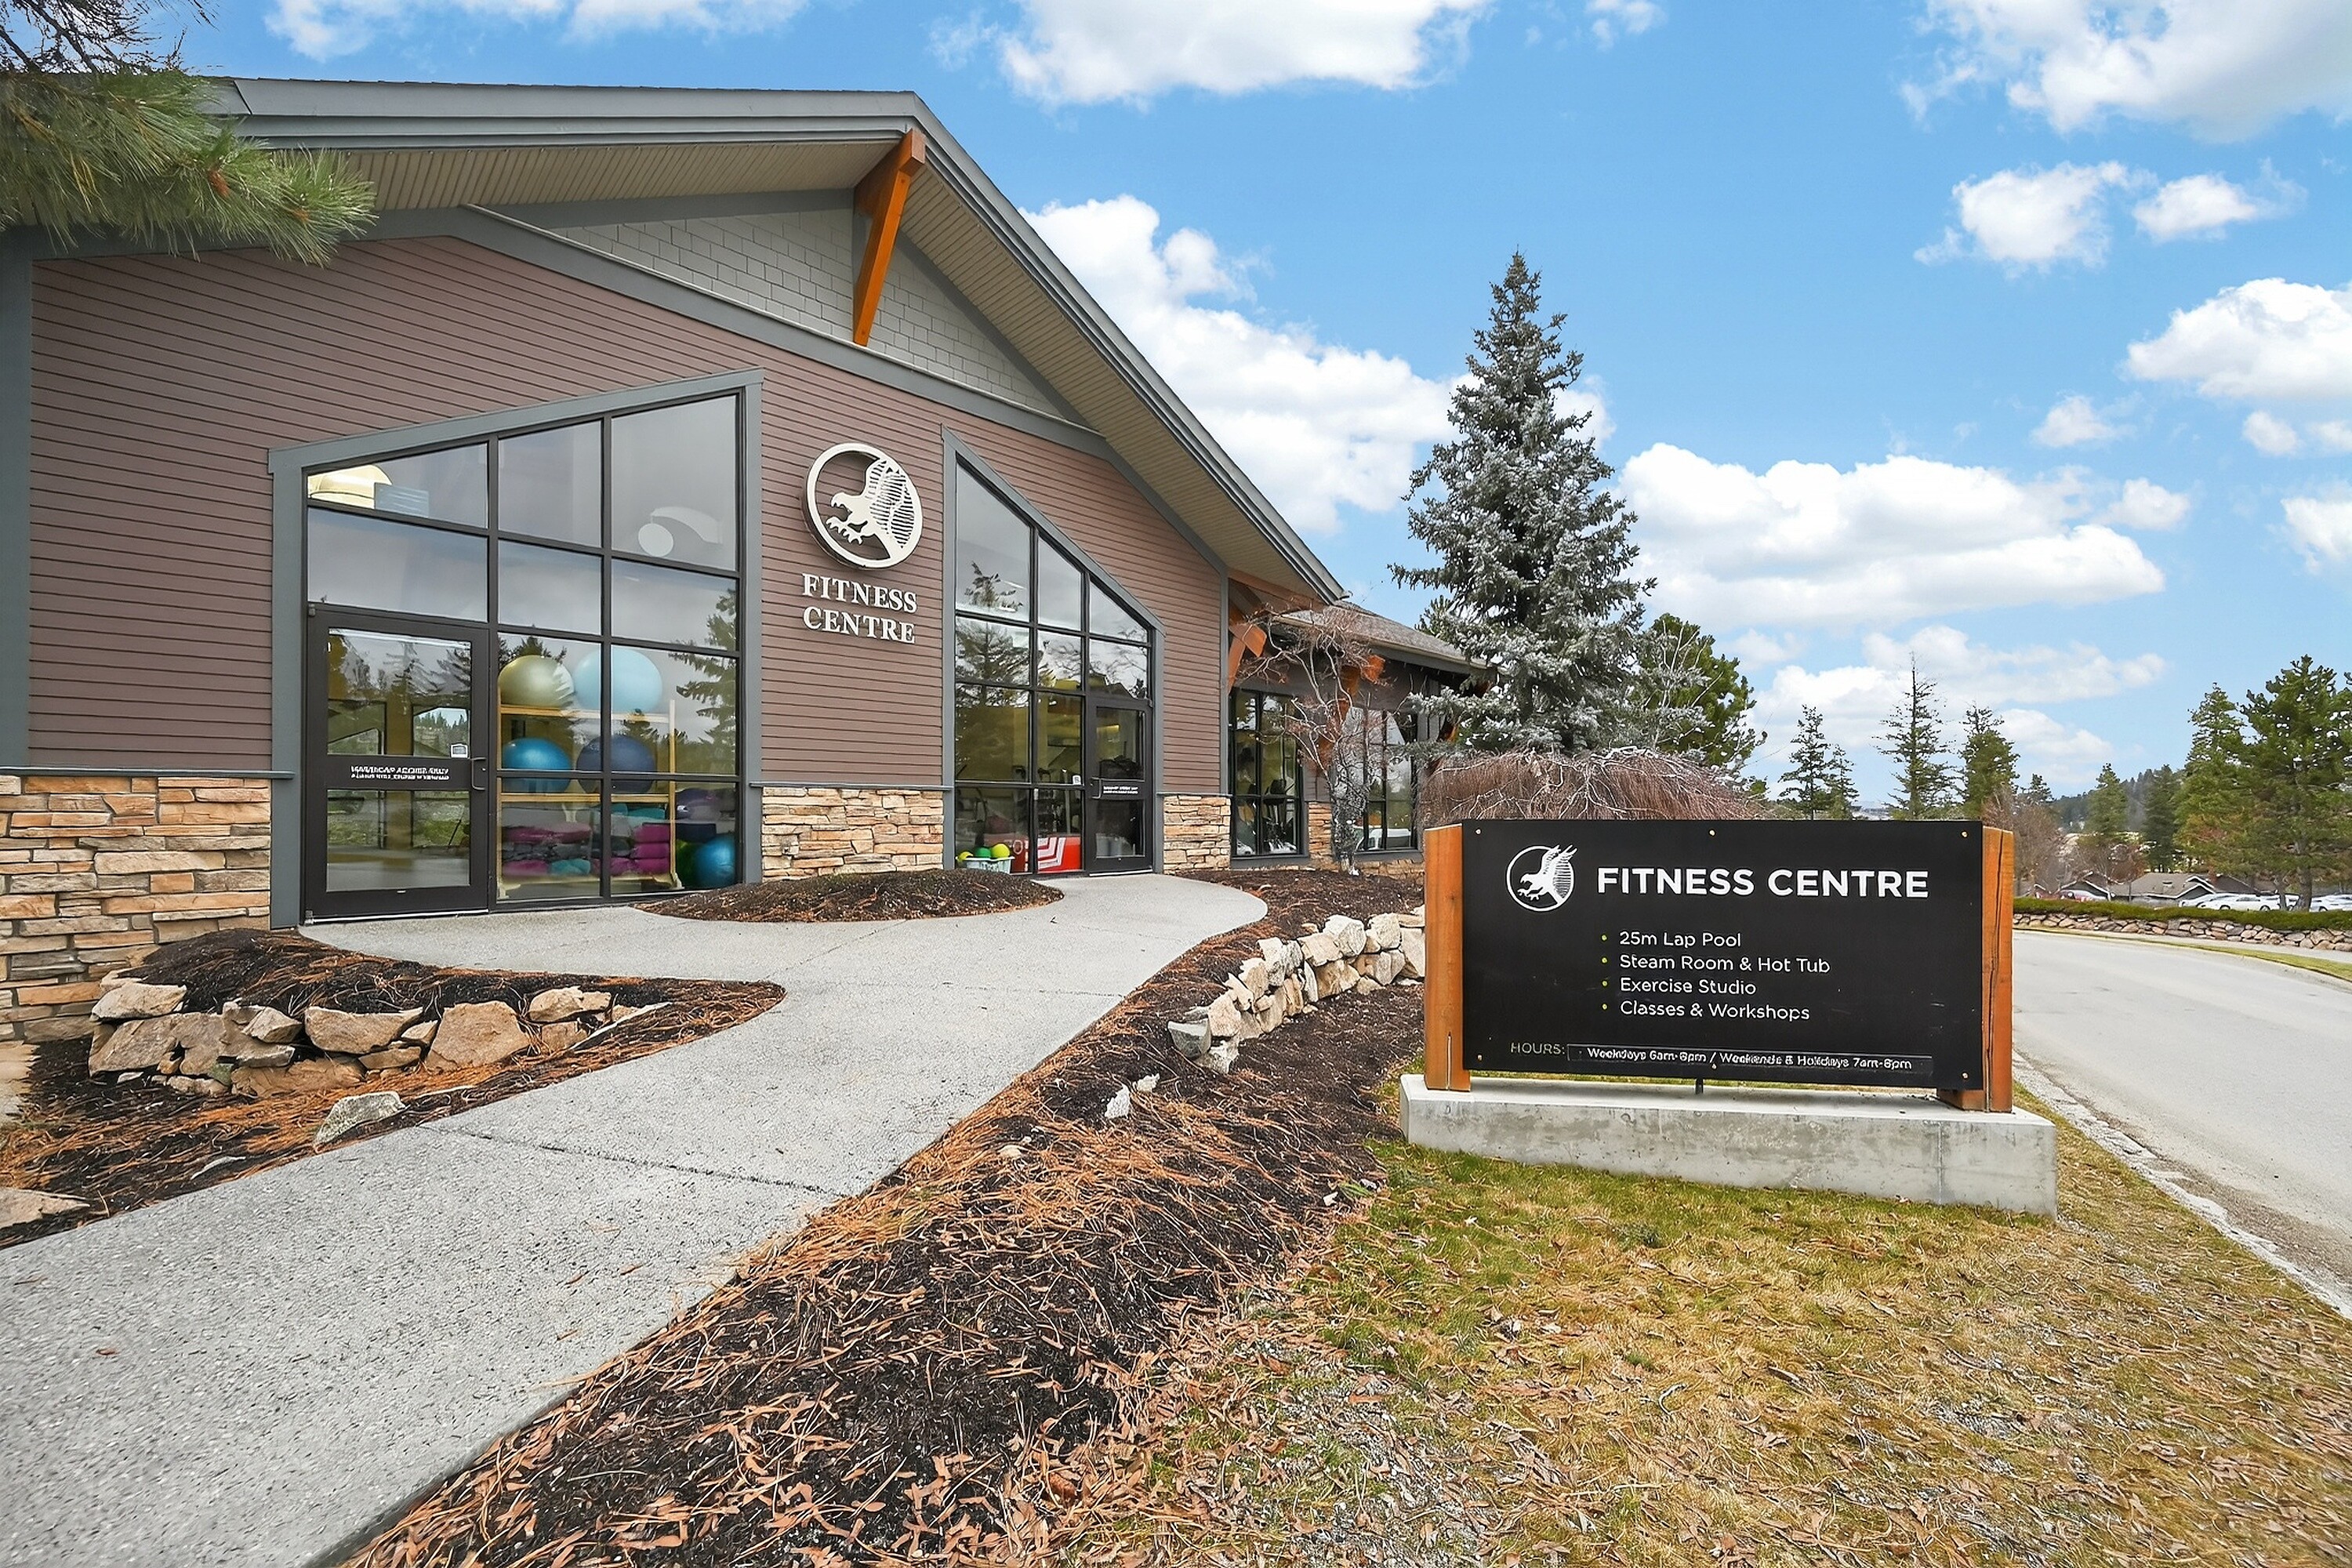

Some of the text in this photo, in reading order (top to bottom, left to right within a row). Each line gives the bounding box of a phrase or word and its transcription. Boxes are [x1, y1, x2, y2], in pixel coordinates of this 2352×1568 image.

[802, 573, 917, 613] FITNESS
[803, 606, 916, 644] CENTRE
[1597, 867, 1929, 898] FITNESS CENTRE
[1620, 931, 1742, 948] 25m Lap Pool
[1620, 954, 1831, 974] Steam Room & Hot Tub
[1620, 977, 1756, 995] Exercise Studio
[1620, 1000, 1810, 1022] Classes & Workshops
[1510, 1042, 1566, 1055] HOURS:
[1587, 1047, 1647, 1062] Weekdays
[1719, 1052, 1783, 1065] Weekends
[1797, 1055, 1850, 1069] Holidays
